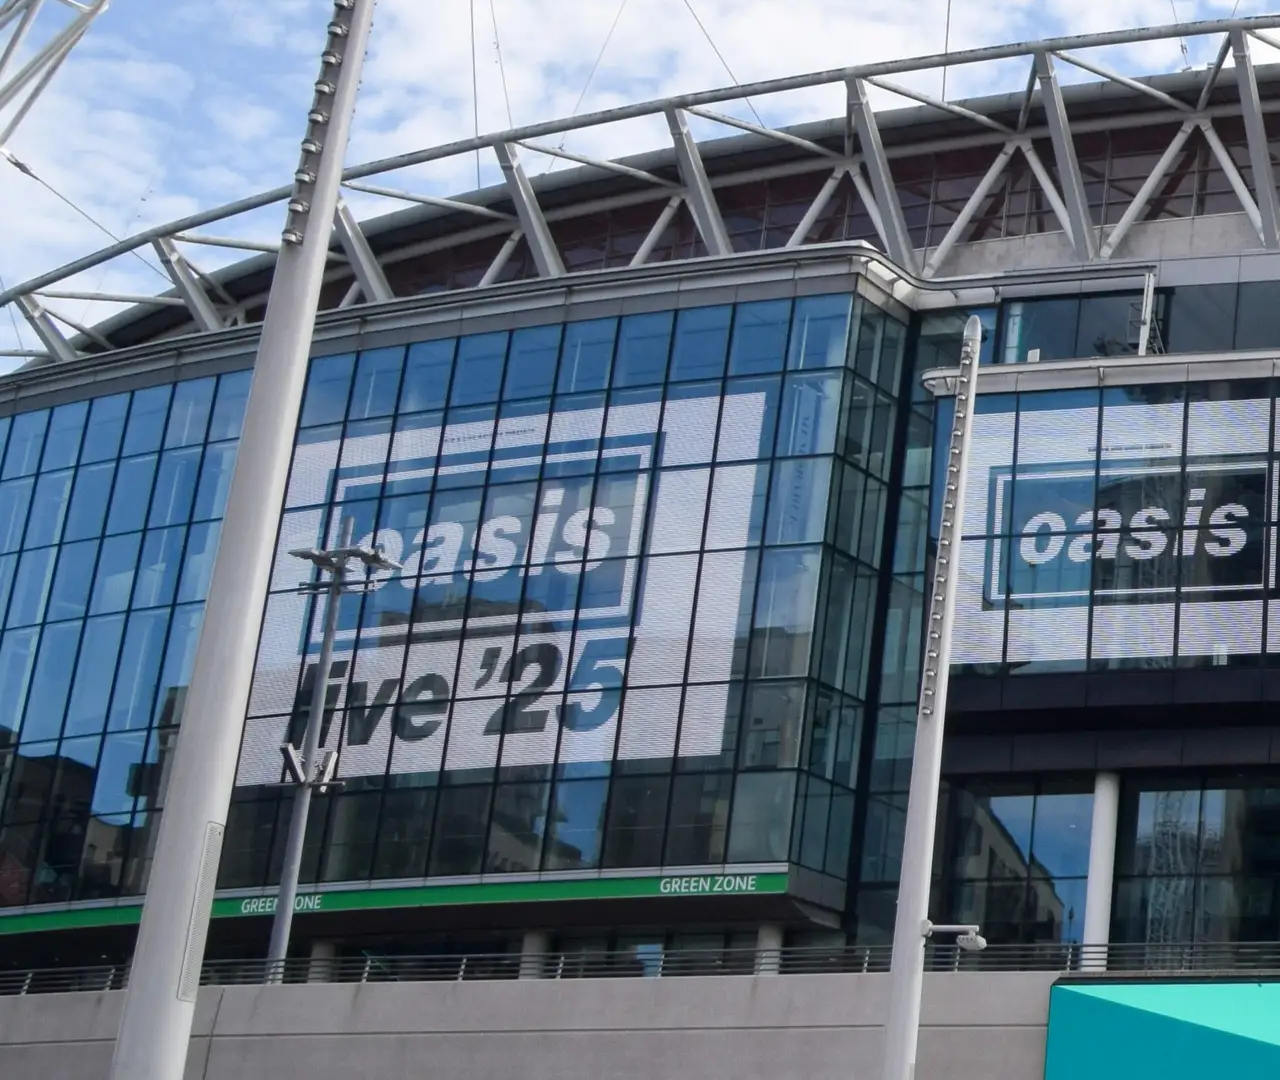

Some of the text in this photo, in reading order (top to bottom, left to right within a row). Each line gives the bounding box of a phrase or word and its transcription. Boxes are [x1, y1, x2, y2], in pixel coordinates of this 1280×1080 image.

[343, 488, 616, 592] oasis
[1019, 488, 1250, 565] oasis
[284, 637, 637, 751] live '25
[295, 894, 322, 910] ONE
[660, 875, 757, 893] GREEN ZONE
